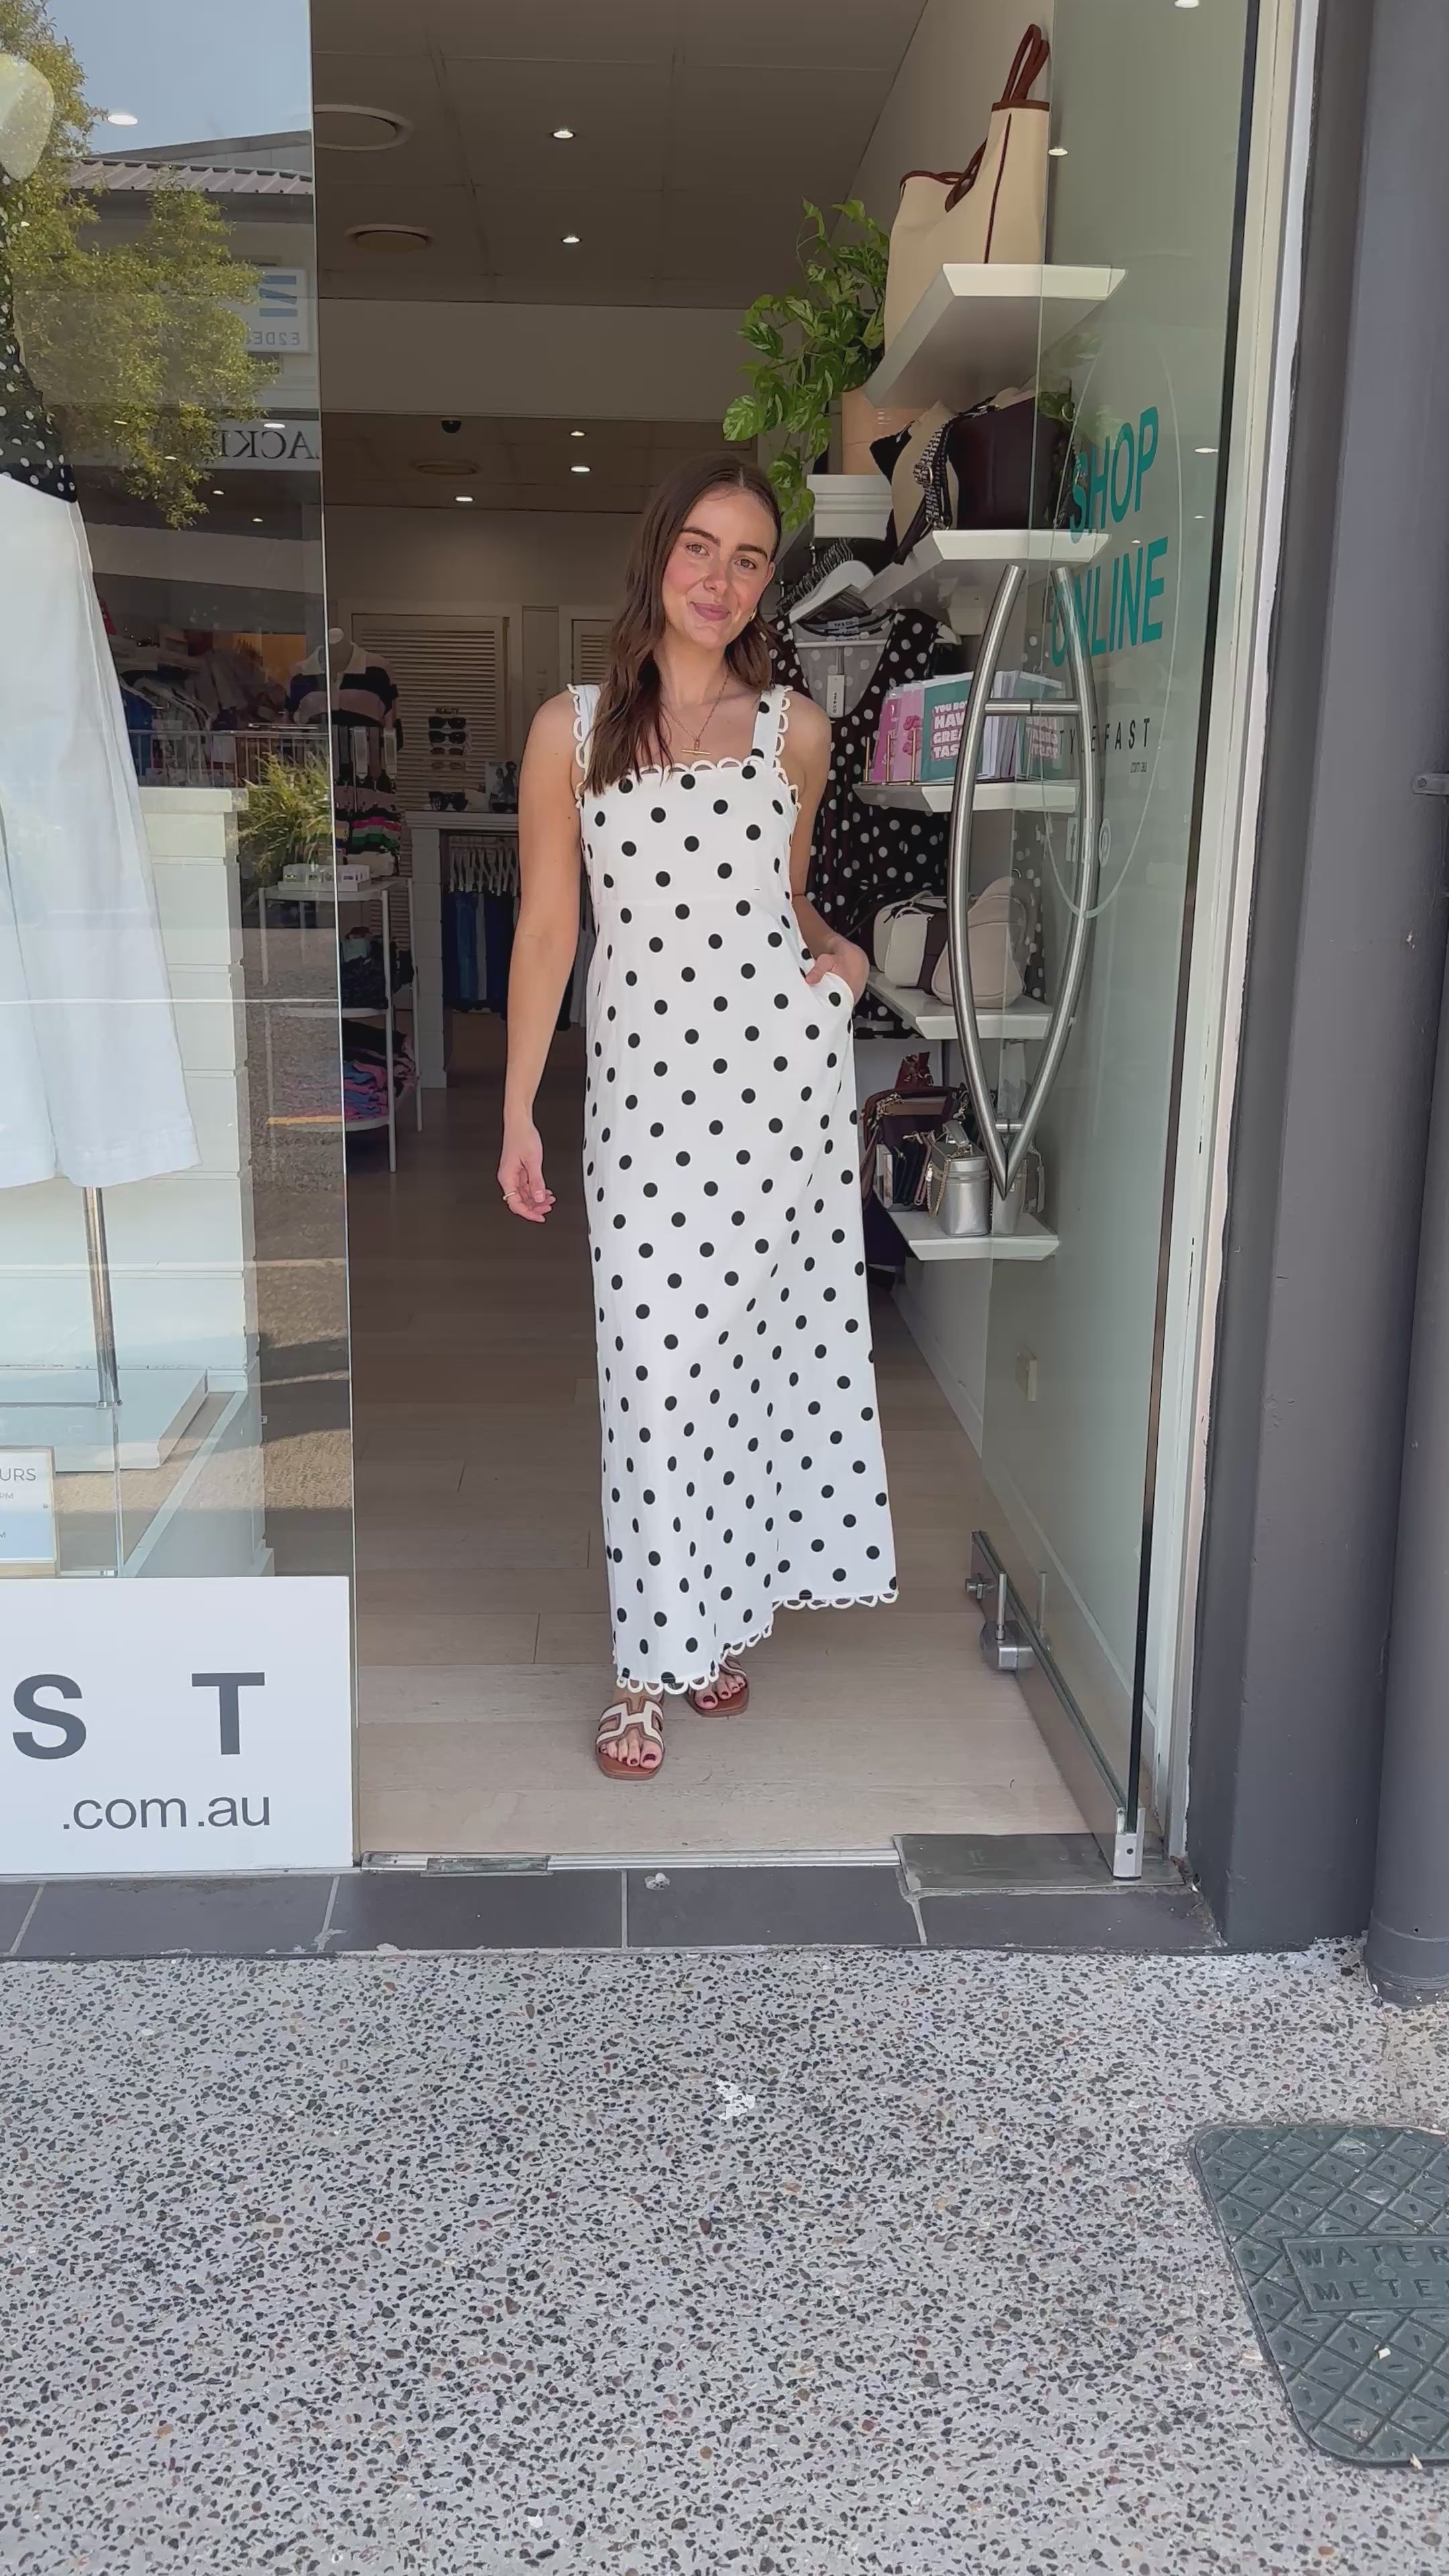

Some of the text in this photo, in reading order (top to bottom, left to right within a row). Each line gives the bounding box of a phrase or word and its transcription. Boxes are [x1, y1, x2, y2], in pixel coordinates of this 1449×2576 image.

[1069, 406, 1159, 544] SHOP
[1052, 537, 1169, 667] ONLINE
[934, 702, 952, 714] YOU
[934, 711, 966, 730] HAV
[932, 743, 960, 759] TAS
[62, 1796, 271, 1830] .com.au
[1297, 2245, 1449, 2267] WATER
